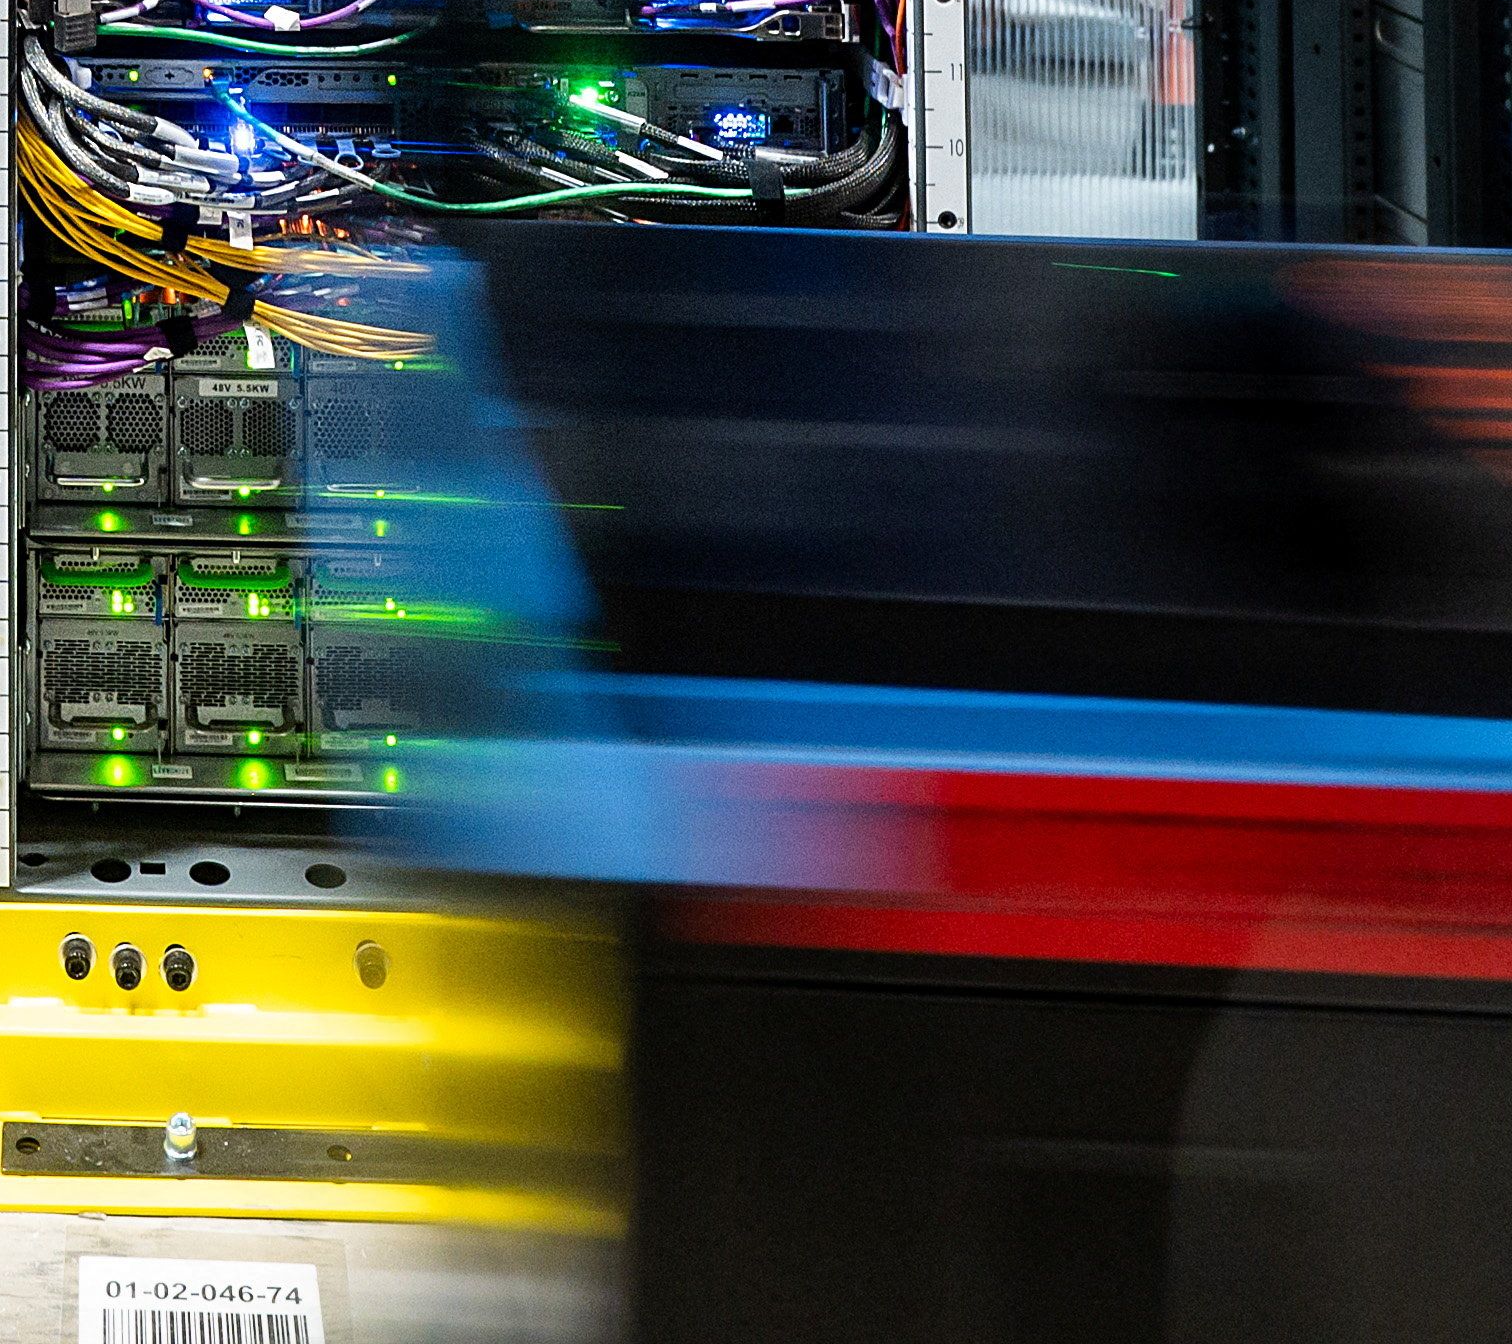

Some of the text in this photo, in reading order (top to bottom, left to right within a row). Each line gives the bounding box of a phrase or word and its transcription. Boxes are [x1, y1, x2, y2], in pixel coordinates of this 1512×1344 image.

[951, 63, 962, 80] 11
[950, 139, 963, 156] 10
[212, 383, 232, 393] 48V
[106, 1281, 302, 1304] 01-02-046-74
